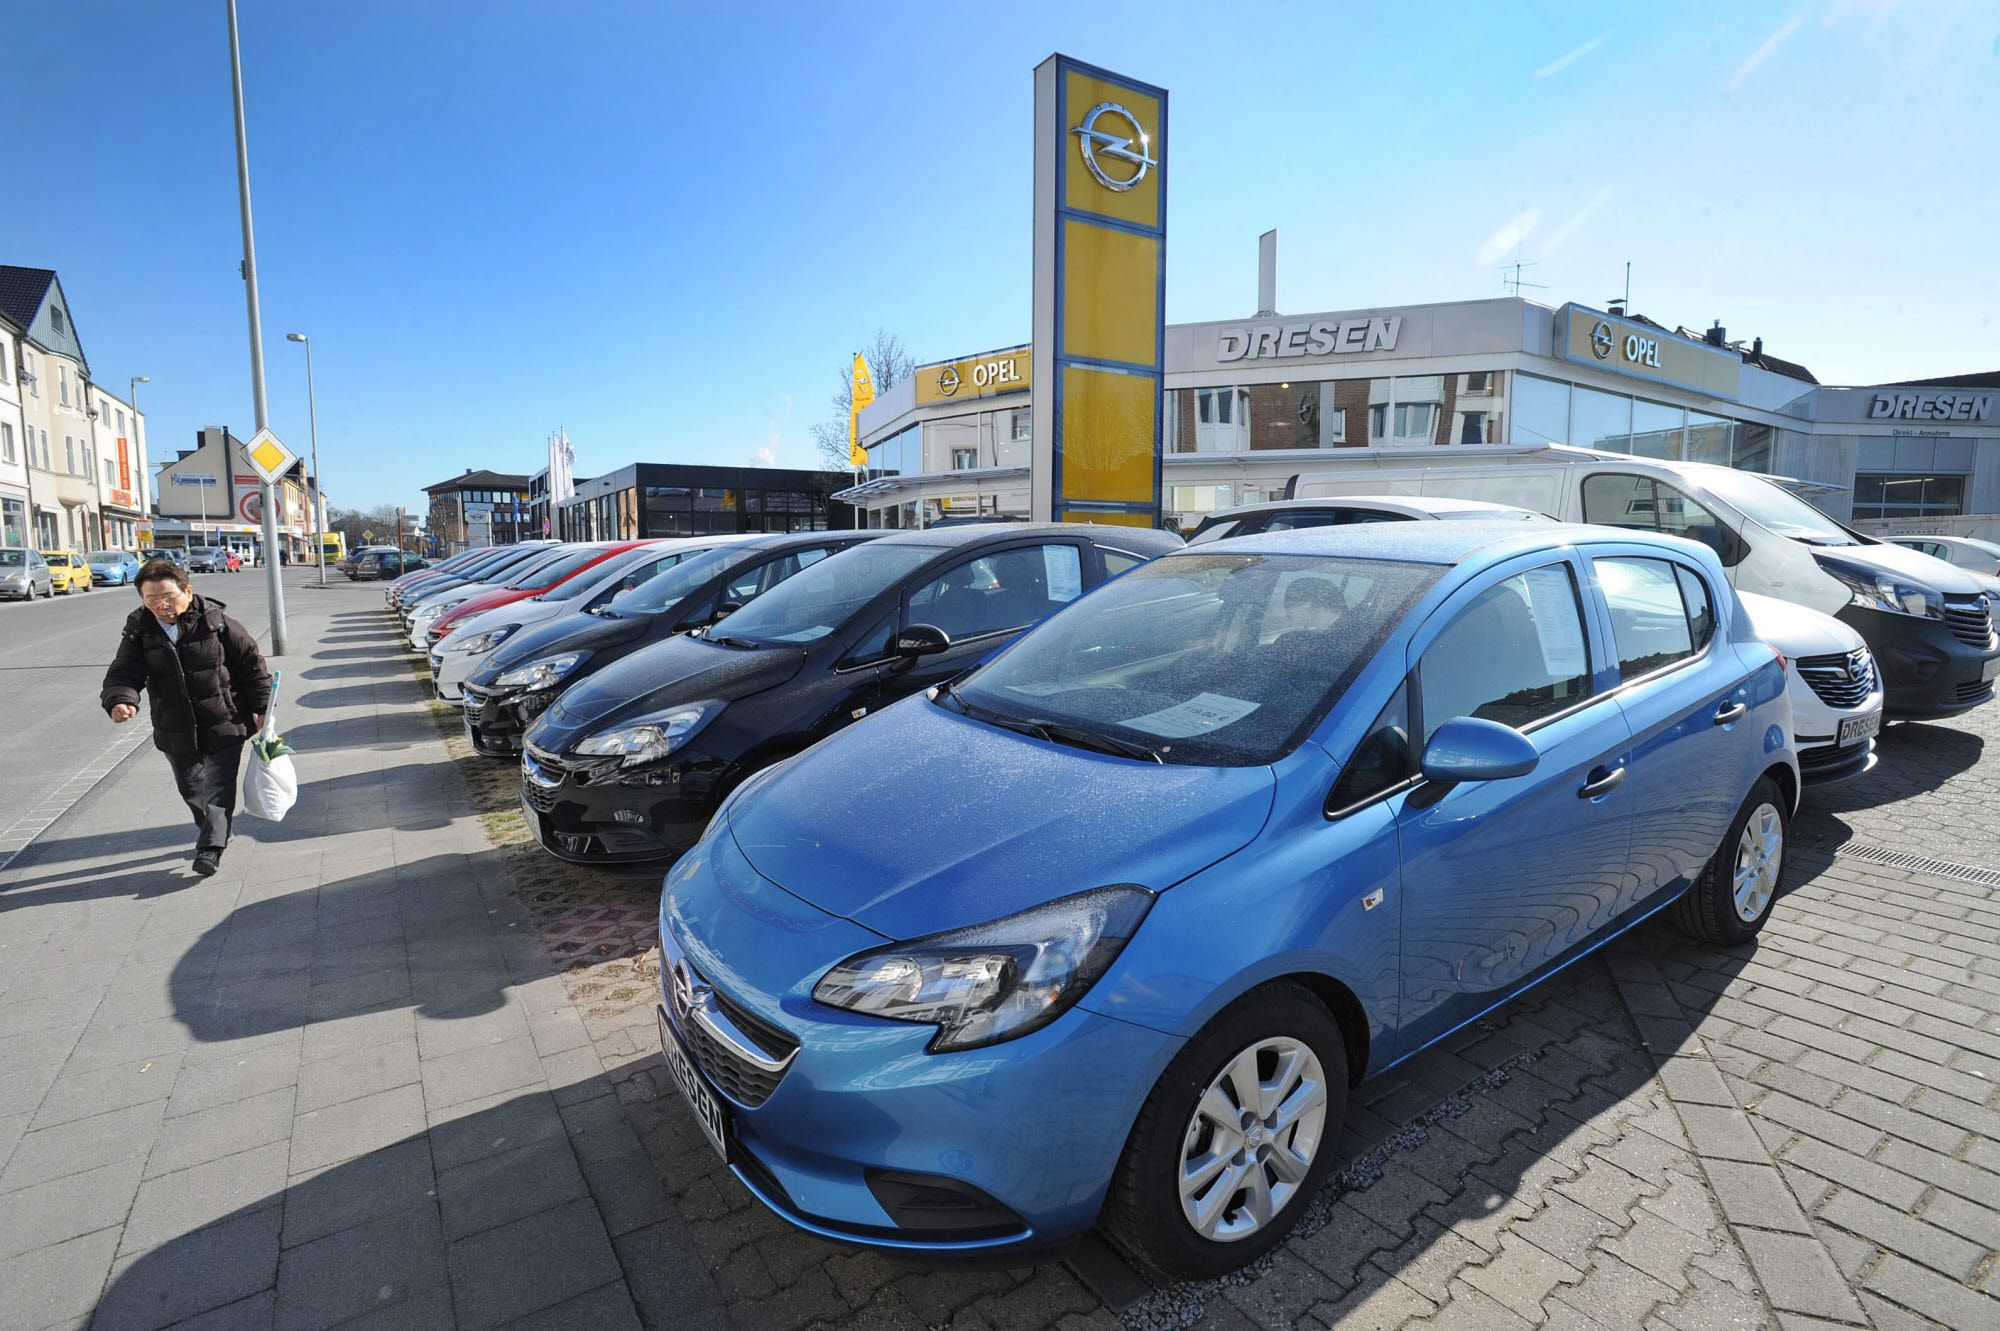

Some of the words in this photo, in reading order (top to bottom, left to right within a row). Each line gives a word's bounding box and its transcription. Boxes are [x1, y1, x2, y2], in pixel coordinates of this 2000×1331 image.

[1216, 316, 1402, 362] DRESEN
[1626, 334, 1661, 369] OPEL
[973, 359, 1020, 387] OPEL
[1871, 395, 1993, 420] DRESEN
[1919, 429, 1951, 437] Annahme
[1842, 714, 1880, 740] DRESEN
[661, 1020, 722, 1143] DRESEN
